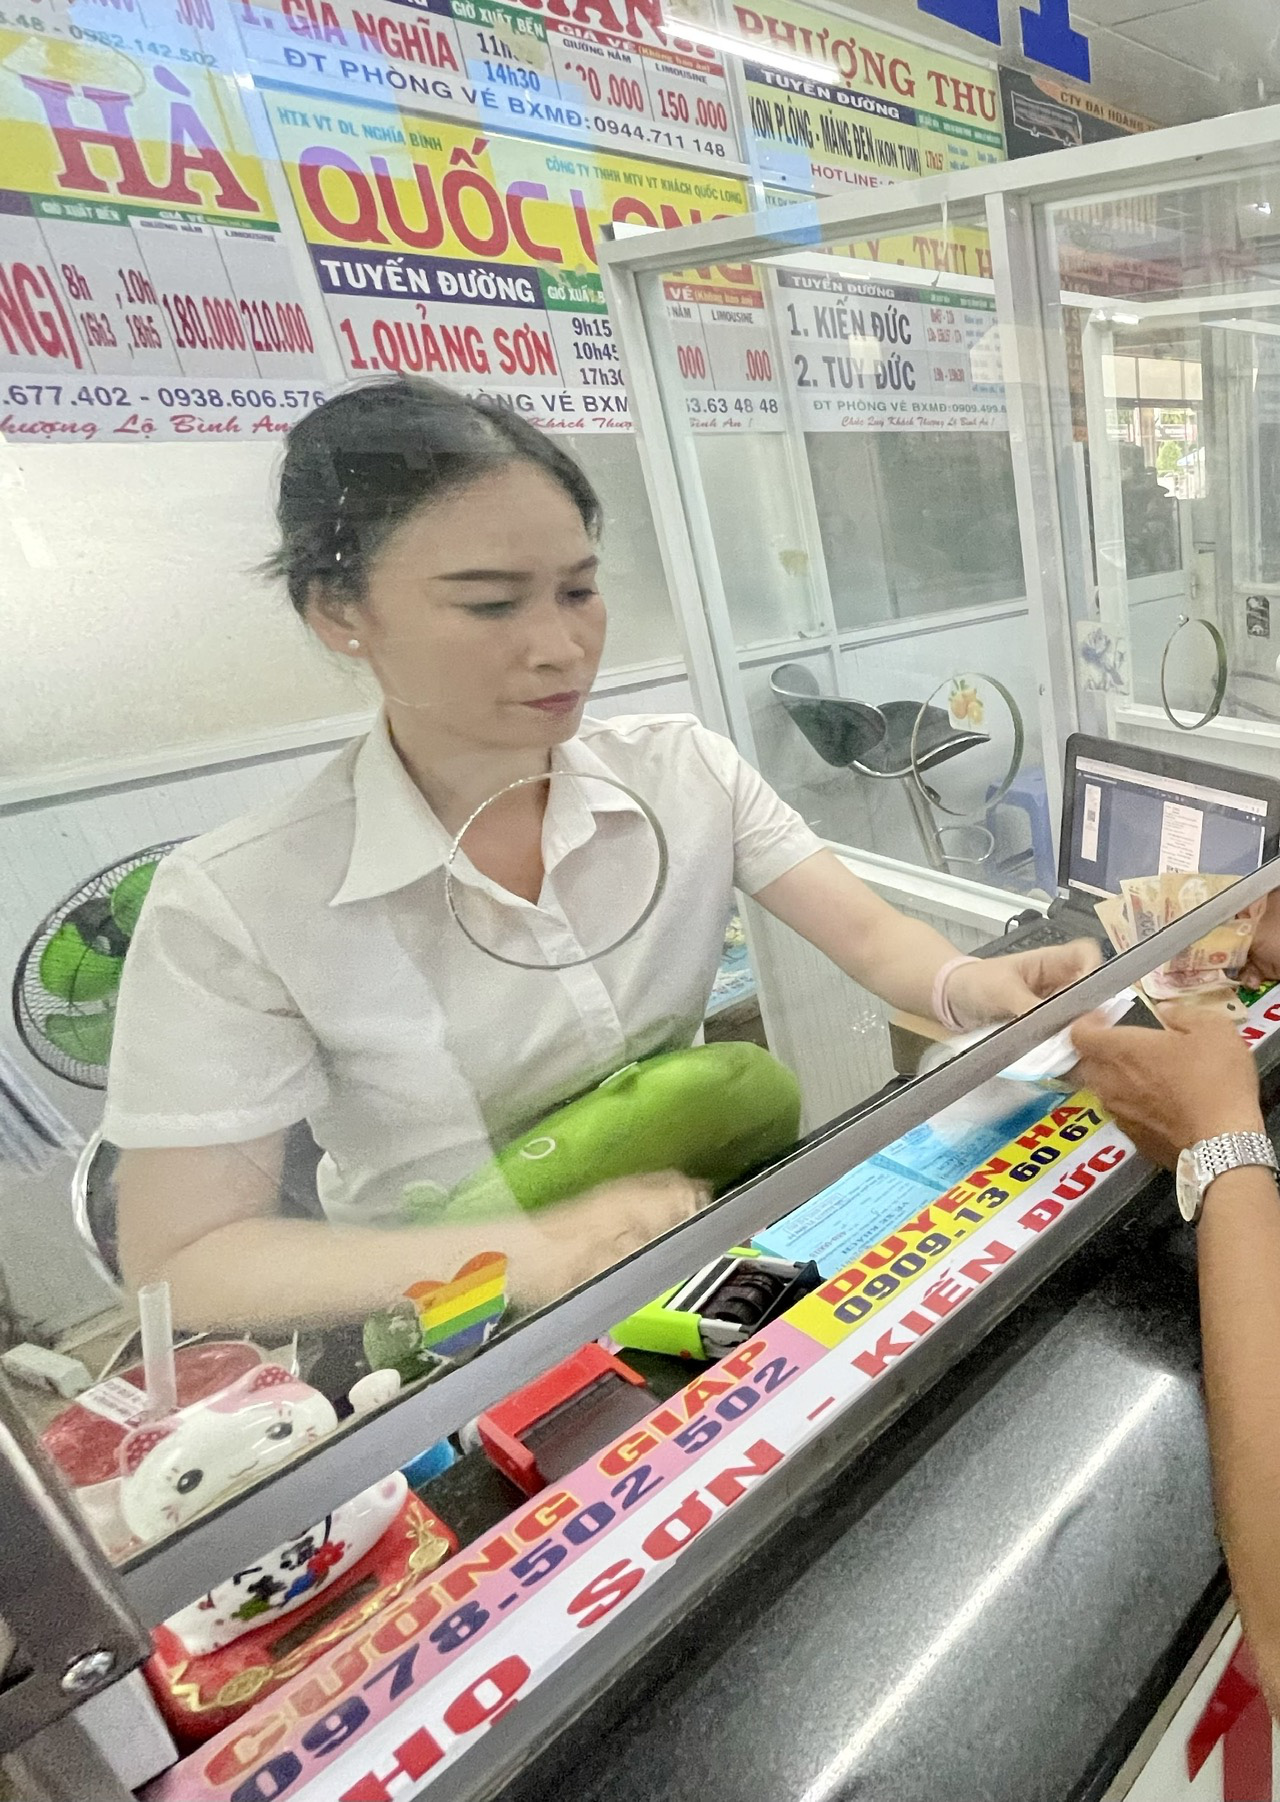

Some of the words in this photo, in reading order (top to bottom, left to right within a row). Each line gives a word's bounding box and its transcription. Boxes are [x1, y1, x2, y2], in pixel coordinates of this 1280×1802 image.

[280, 0, 347, 46] GIA
[352, 10, 459, 72] NGHĨA
[484, 60, 541, 92] 14h30
[654, 62, 708, 84] LIMOUSINE
[927, 70, 996, 122] THU
[284, 47, 327, 72] ĐT
[340, 60, 452, 99] PHÒNG
[461, 88, 499, 109] VÉ
[693, 138, 726, 158] 148
[19, 64, 261, 213] HÀ
[278, 106, 309, 129] HTX
[314, 114, 333, 132] VT
[361, 122, 407, 146] NGHĨA
[408, 131, 444, 151] BÌNH
[298, 136, 564, 265] QUỐC
[546, 157, 576, 176] CÔNG
[577, 163, 591, 178] TY
[593, 166, 621, 182] TNHH
[623, 171, 645, 187] MTV
[661, 177, 693, 196] KHÁCH
[694, 182, 719, 200] QUỐC
[720, 190, 743, 206] LONG
[61, 264, 95, 300] 8h
[320, 256, 431, 294] TUYẾN
[436, 268, 536, 303] ĐƯỜNG
[669, 286, 694, 301] VÉ
[162, 293, 247, 350] 180.000
[240, 299, 315, 354] 210.000
[572, 317, 613, 338] 9h15
[711, 308, 754, 325] LIMOUSINE
[787, 303, 809, 337] 1.
[813, 296, 866, 341] KIẾN
[870, 304, 912, 345] ĐỨC
[493, 323, 558, 376] SƠN
[794, 353, 819, 387] 2.
[873, 351, 916, 391] ĐỨC
[158, 388, 327, 408] 0938.606.576
[541, 390, 575, 412] VÉ
[760, 398, 779, 413] 48
[813, 400, 831, 411] ĐT
[837, 398, 887, 412] PHÒNG
[892, 399, 908, 412] VÉ
[113, 414, 157, 439] Lộ
[170, 414, 243, 434] Bình
[1009, 1145, 1061, 1182] 60
[1059, 1108, 1103, 1142] 67
[566, 1438, 786, 1629] SƠN
[806, 1396, 836, 1421] -
[851, 1239, 1017, 1379] KIẾN
[1018, 1145, 1126, 1233] ĐỨC
[673, 1356, 800, 1455] 502
[204, 1490, 583, 1787] CƯỜNG
